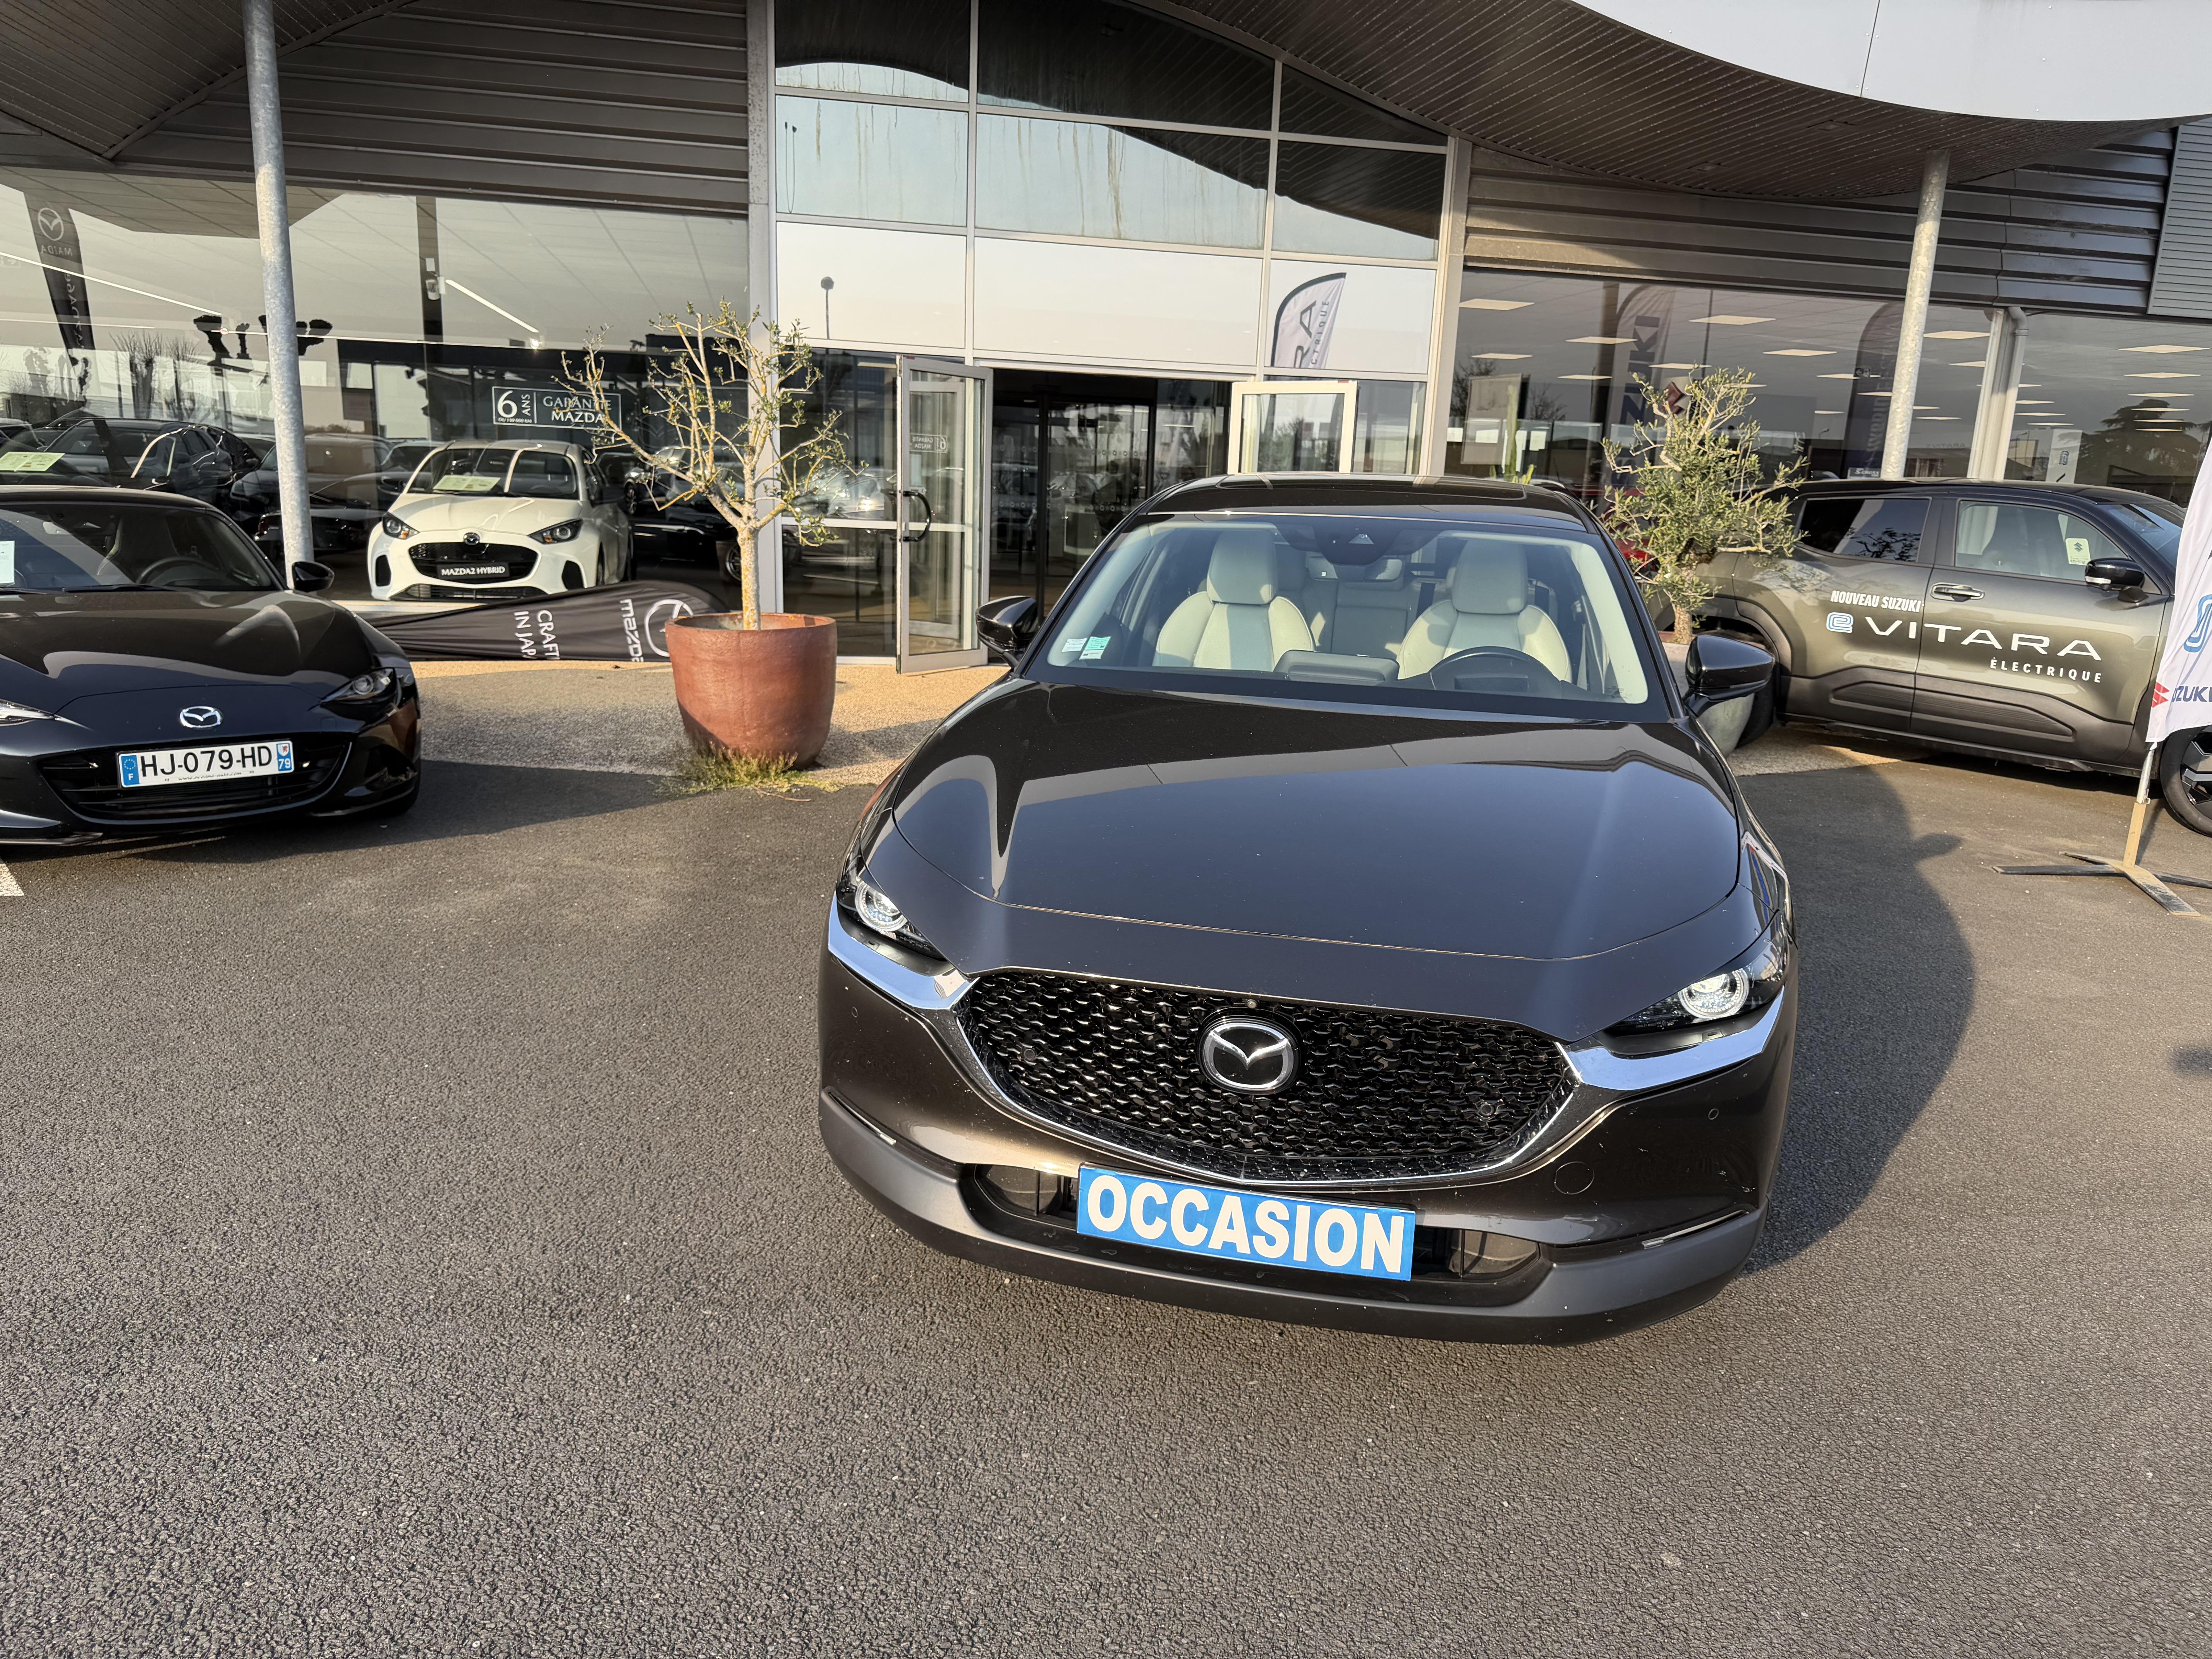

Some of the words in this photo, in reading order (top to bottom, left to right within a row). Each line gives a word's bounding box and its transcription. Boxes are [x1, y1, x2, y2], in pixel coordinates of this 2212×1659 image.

[497, 390, 518, 418] 6
[522, 394, 531, 416] ANS
[543, 396, 611, 410] GARANIE
[441, 567, 476, 576] MAZDA2
[476, 566, 505, 574] HYBRID
[1830, 590, 1880, 607] NOUVEAU
[1881, 596, 1921, 612] SUZUKI
[514, 611, 531, 629] IN
[537, 610, 561, 660] CRAFT
[1865, 617, 2102, 661] VITARA
[1990, 657, 2102, 683] ÉLECTRIQUE
[140, 746, 271, 777] HJ-079-HD
[278, 758, 291, 769] 79
[1087, 1175, 1405, 1273] OCCASION
